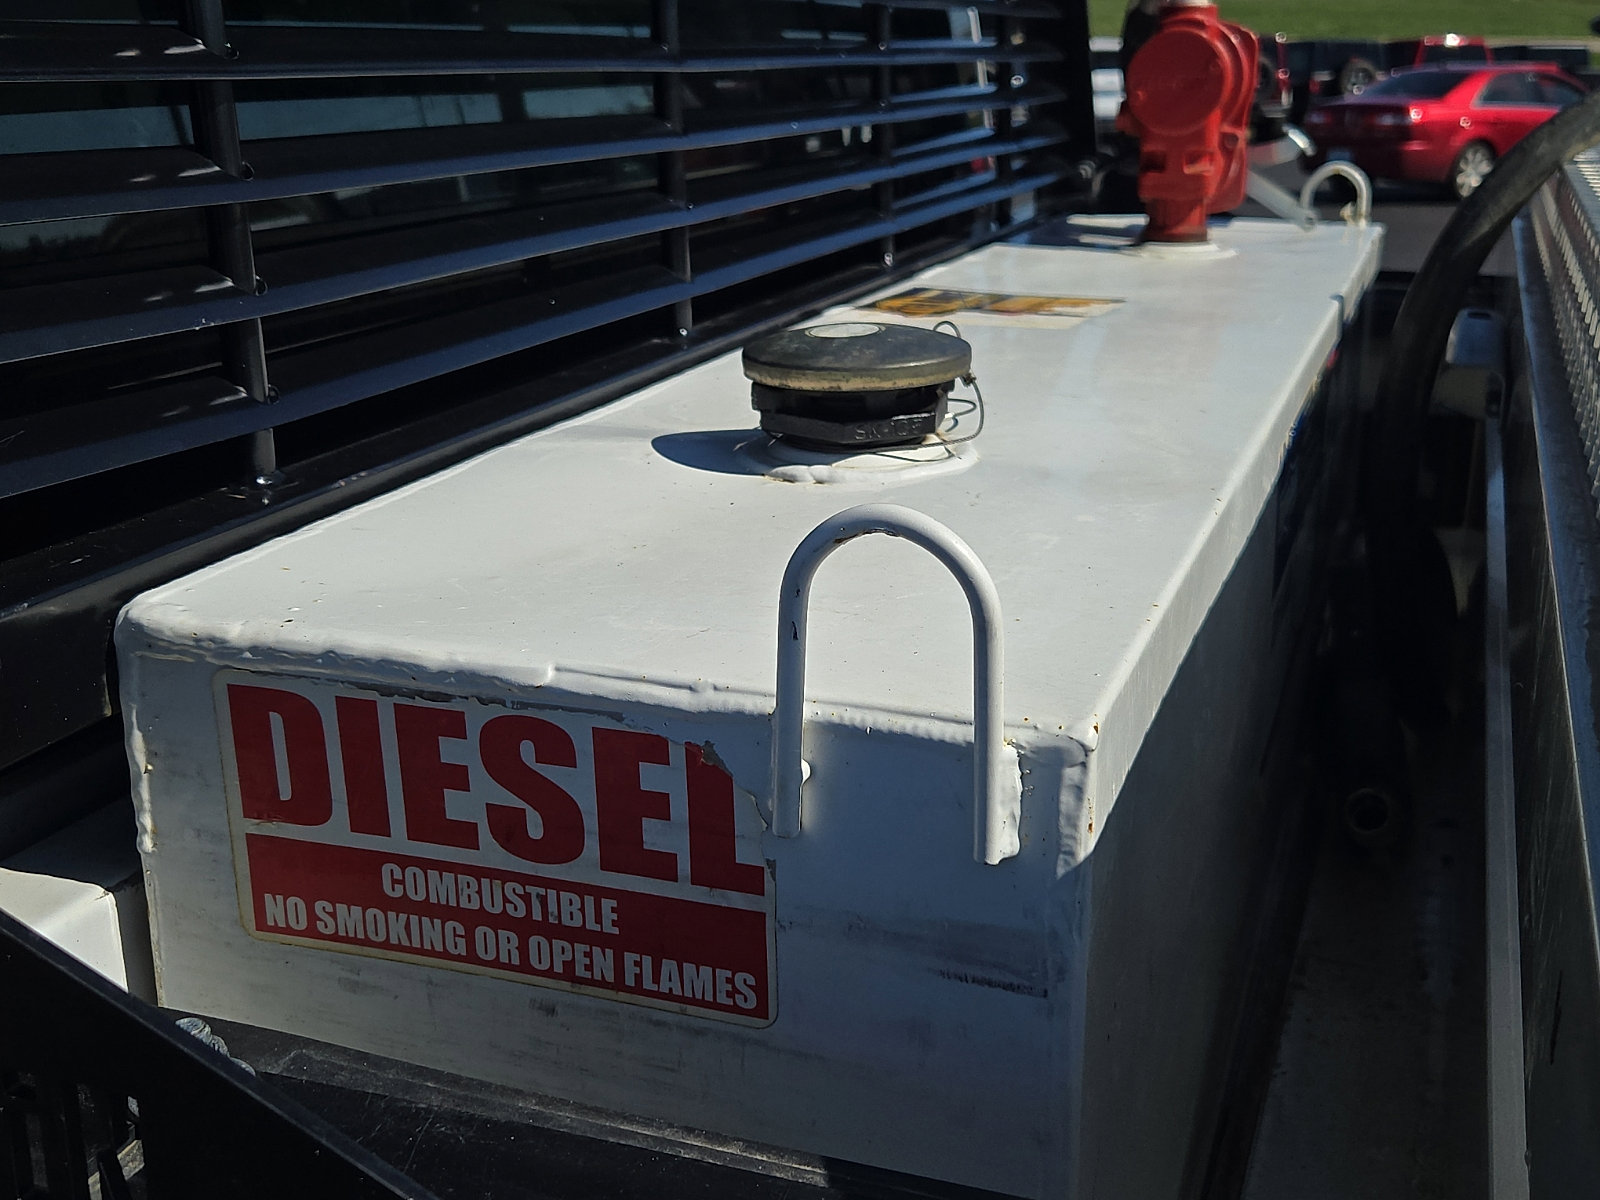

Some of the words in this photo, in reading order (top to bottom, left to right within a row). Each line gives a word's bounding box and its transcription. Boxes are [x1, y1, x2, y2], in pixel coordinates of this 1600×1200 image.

[227, 684, 765, 896] DIESEL
[264, 893, 307, 930] NO
[314, 900, 467, 956] SMOKING
[475, 926, 520, 966] OR
[528, 935, 615, 983] OPEN
[624, 951, 758, 1010] FLAMES
[382, 863, 619, 935] COMBUSTIBLE
